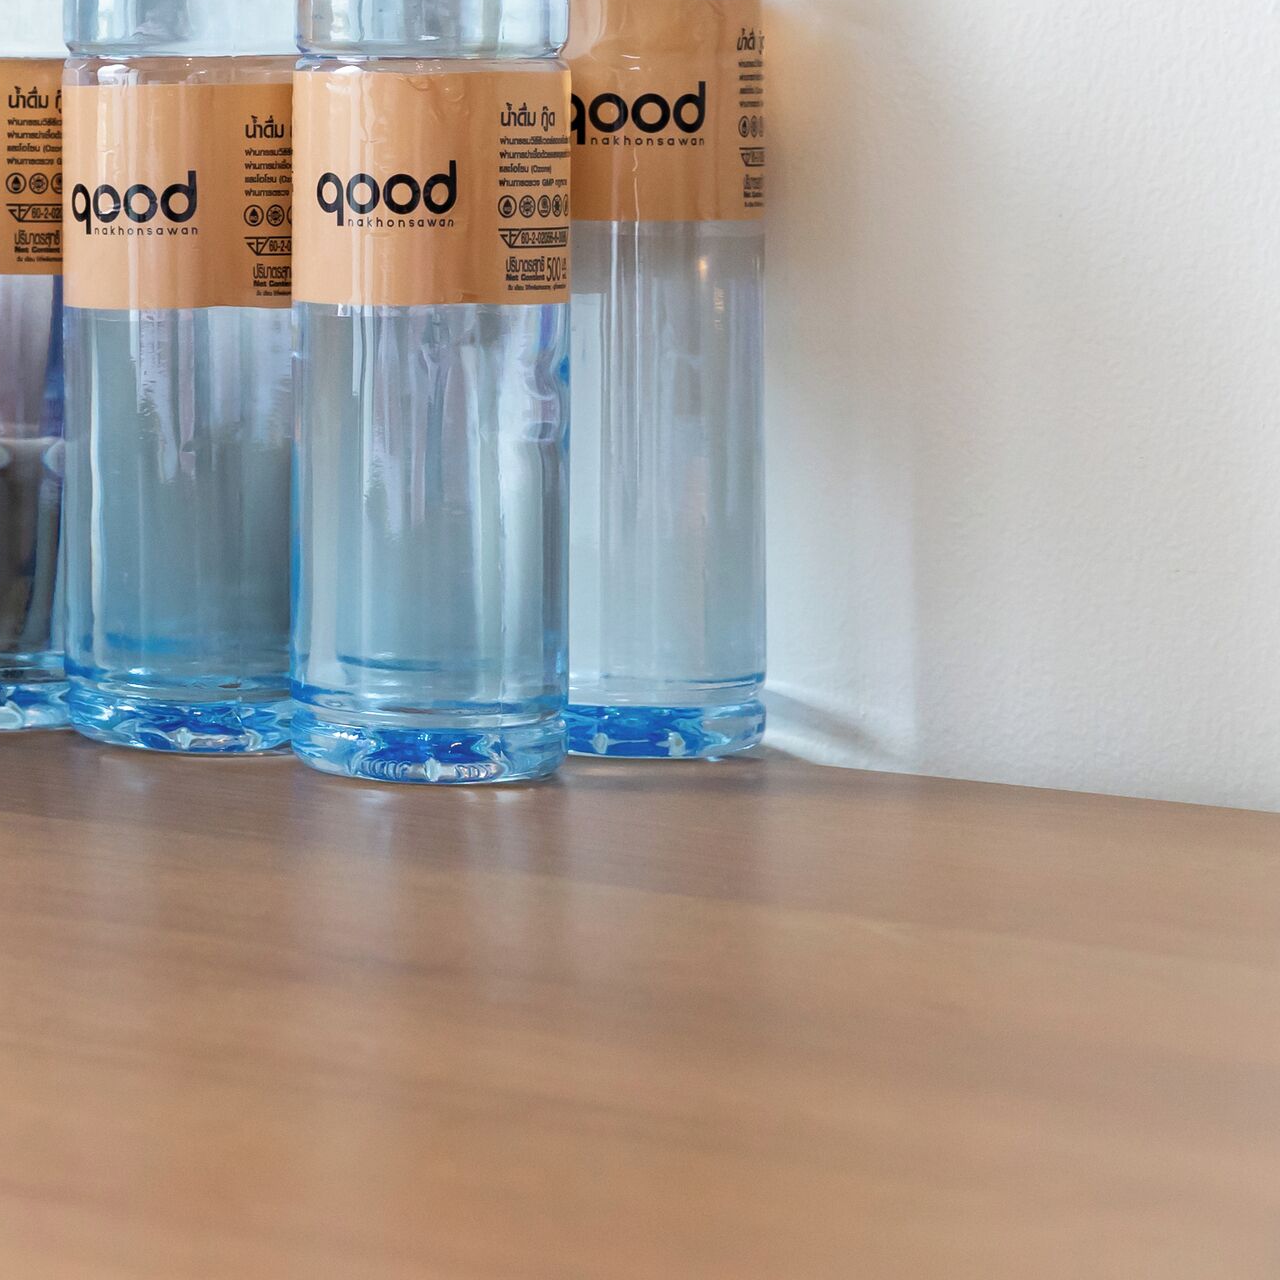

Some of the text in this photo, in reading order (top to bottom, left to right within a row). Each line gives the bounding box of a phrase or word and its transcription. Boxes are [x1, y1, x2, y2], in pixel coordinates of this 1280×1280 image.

[501, 102, 536, 127] น้ำดื่ม
[245, 115, 285, 139] น้ำดื่ม
[591, 136, 704, 146] nakhonsawan
[94, 226, 198, 235] nakhonsawan
[348, 217, 454, 227] nakhonsawan
[546, 257, 561, 281] 500
